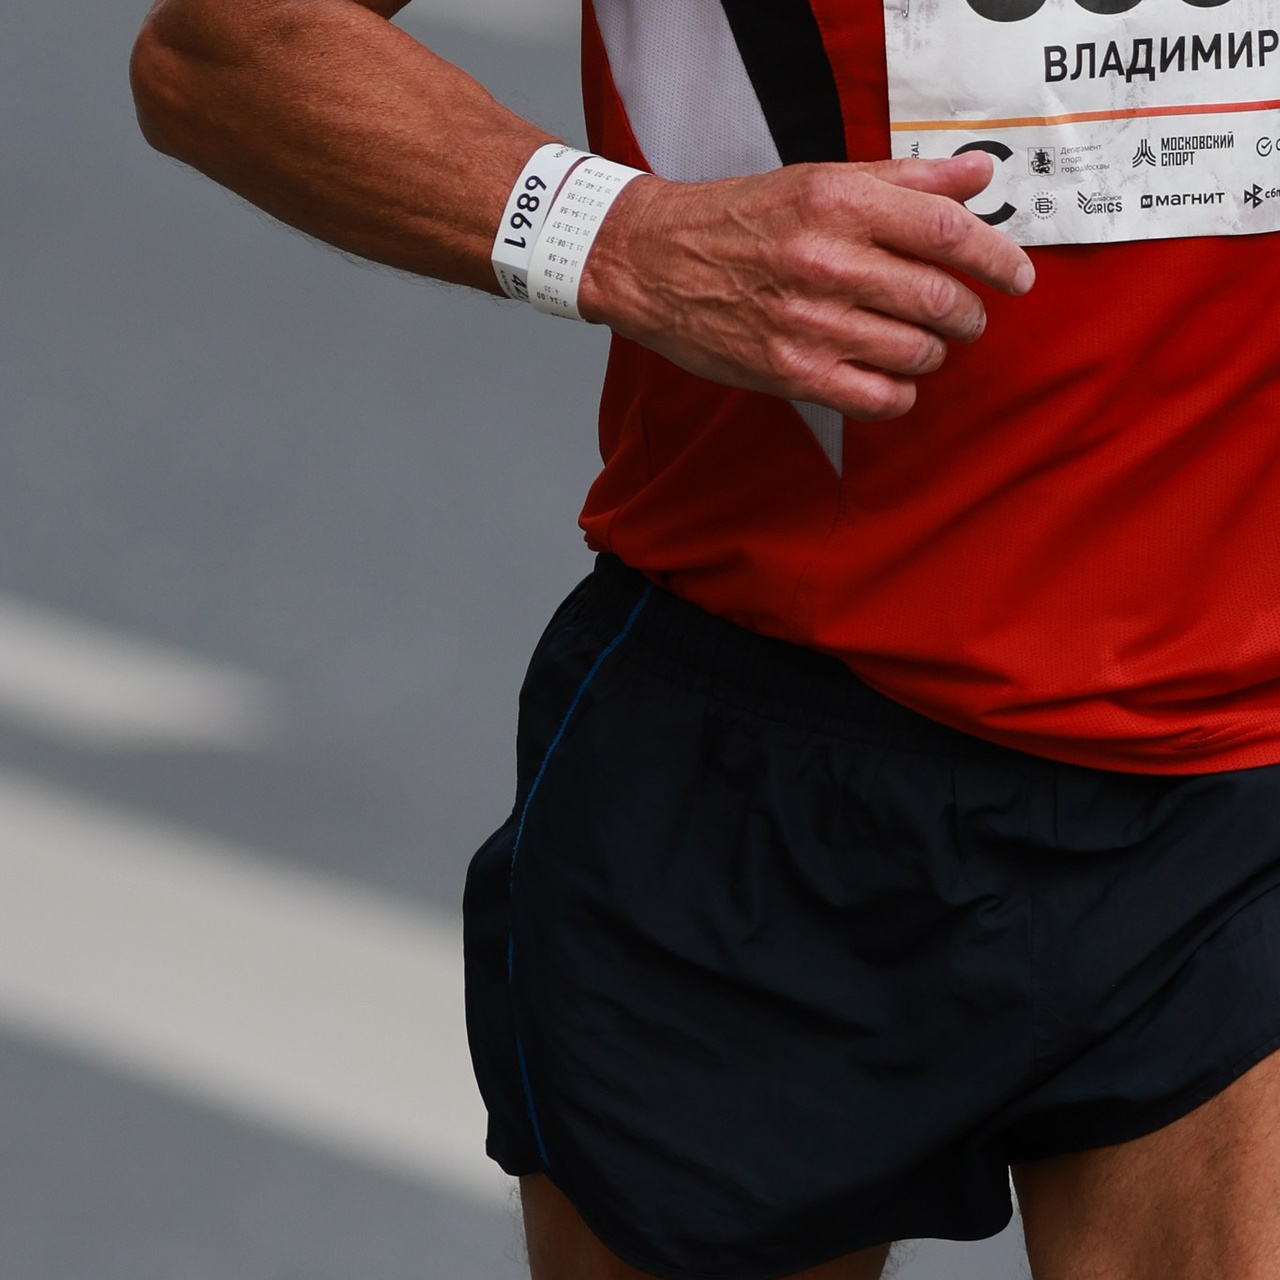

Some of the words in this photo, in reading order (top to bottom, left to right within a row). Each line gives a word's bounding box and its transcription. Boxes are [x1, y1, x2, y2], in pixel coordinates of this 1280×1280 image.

[1044, 29, 1280, 84] ВЛАДИМИР
[1160, 131, 1235, 152] МОСКОВСКИЙ
[1160, 152, 1195, 167] СПОРТ
[574, 179, 603, 193] 2:40:55
[566, 192, 595, 206] 2:17:55
[1156, 192, 1226, 206] магнит
[503, 175, 547, 249] 6861
[552, 220, 580, 235] 1:31:57
[546, 235, 575, 250] 1:08:57
[544, 269, 564, 282] 22:59
